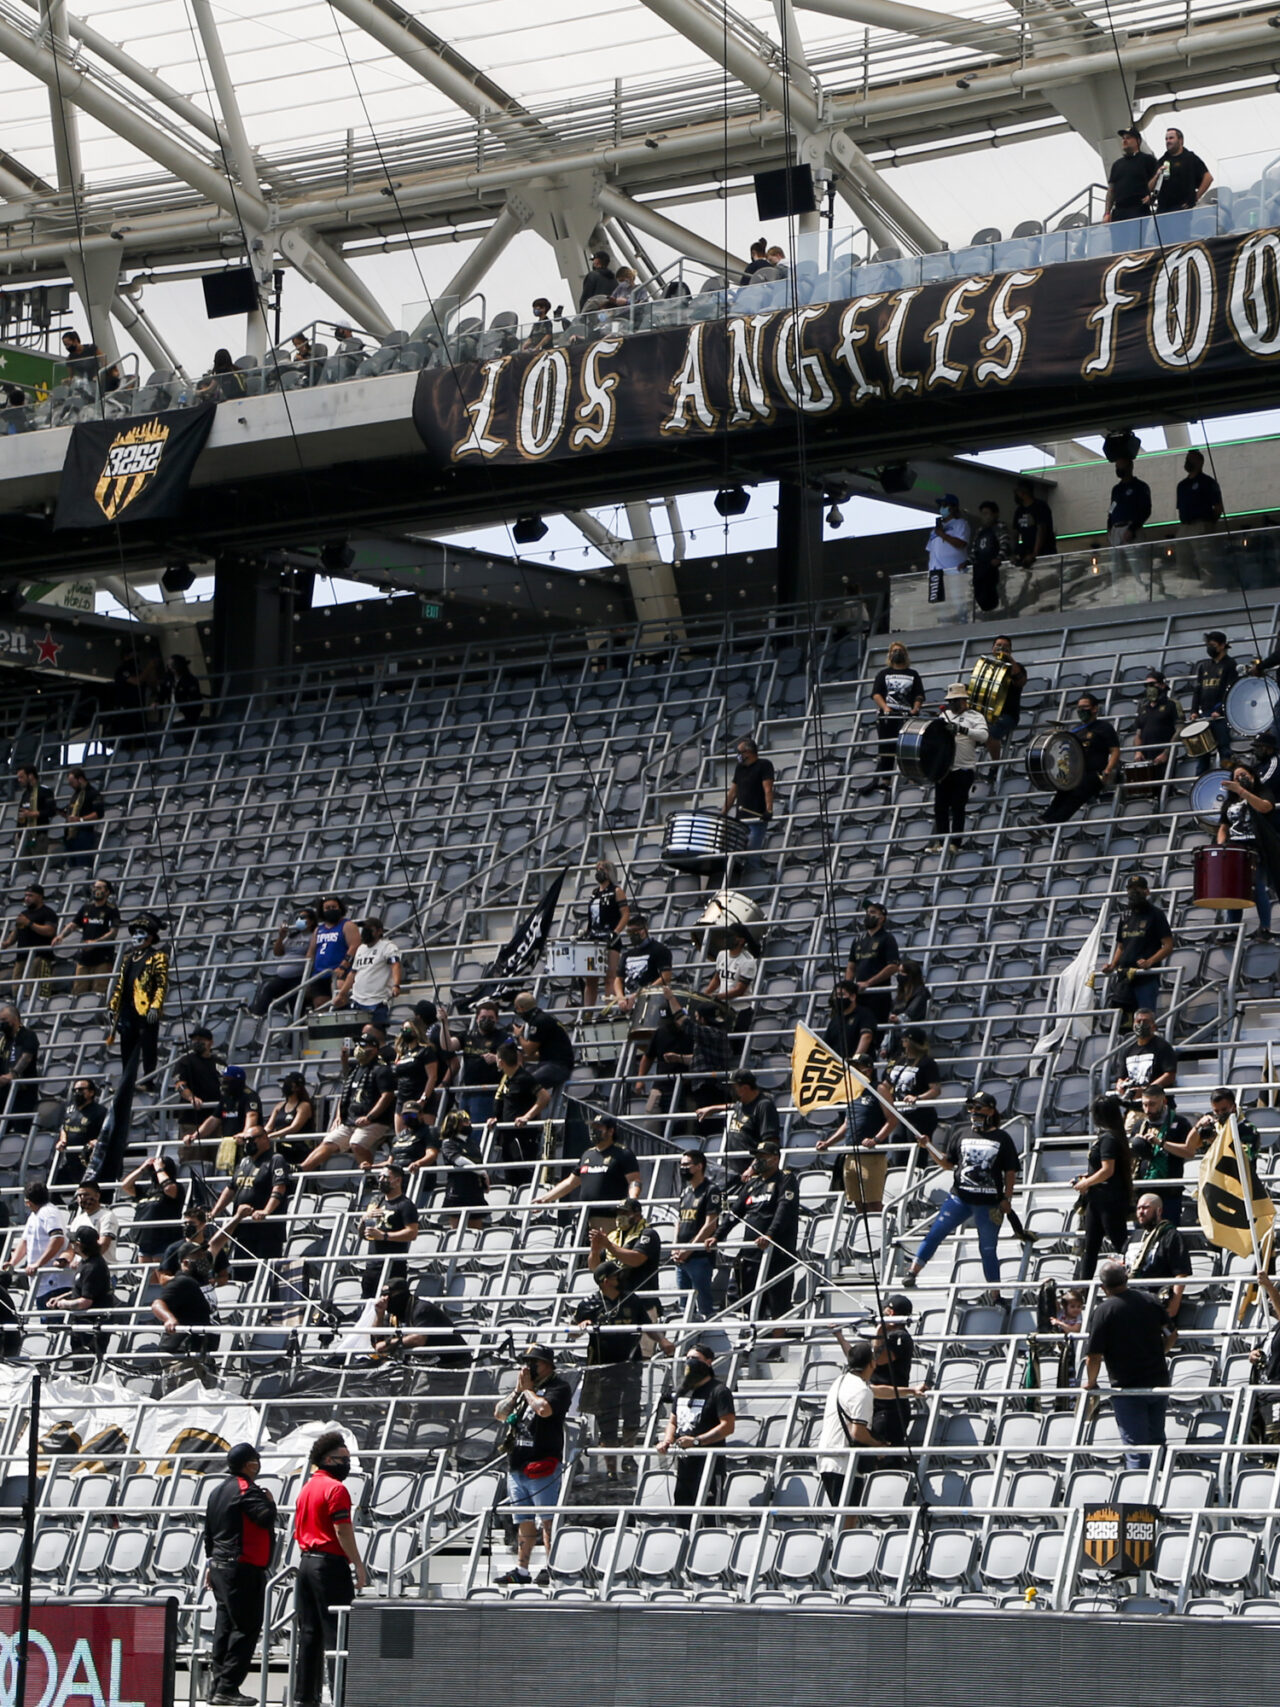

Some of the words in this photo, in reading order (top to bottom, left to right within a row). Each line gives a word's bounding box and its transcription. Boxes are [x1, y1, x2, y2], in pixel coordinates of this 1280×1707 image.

[452, 338, 623, 460] LOS
[661, 271, 1041, 434] ANGELES
[106, 441, 162, 477] 3252
[425, 604, 439, 619] EXIT
[320, 943, 328, 955] 2
[1085, 1521, 1118, 1540] 3252
[1126, 1522, 1154, 1540] 3252
